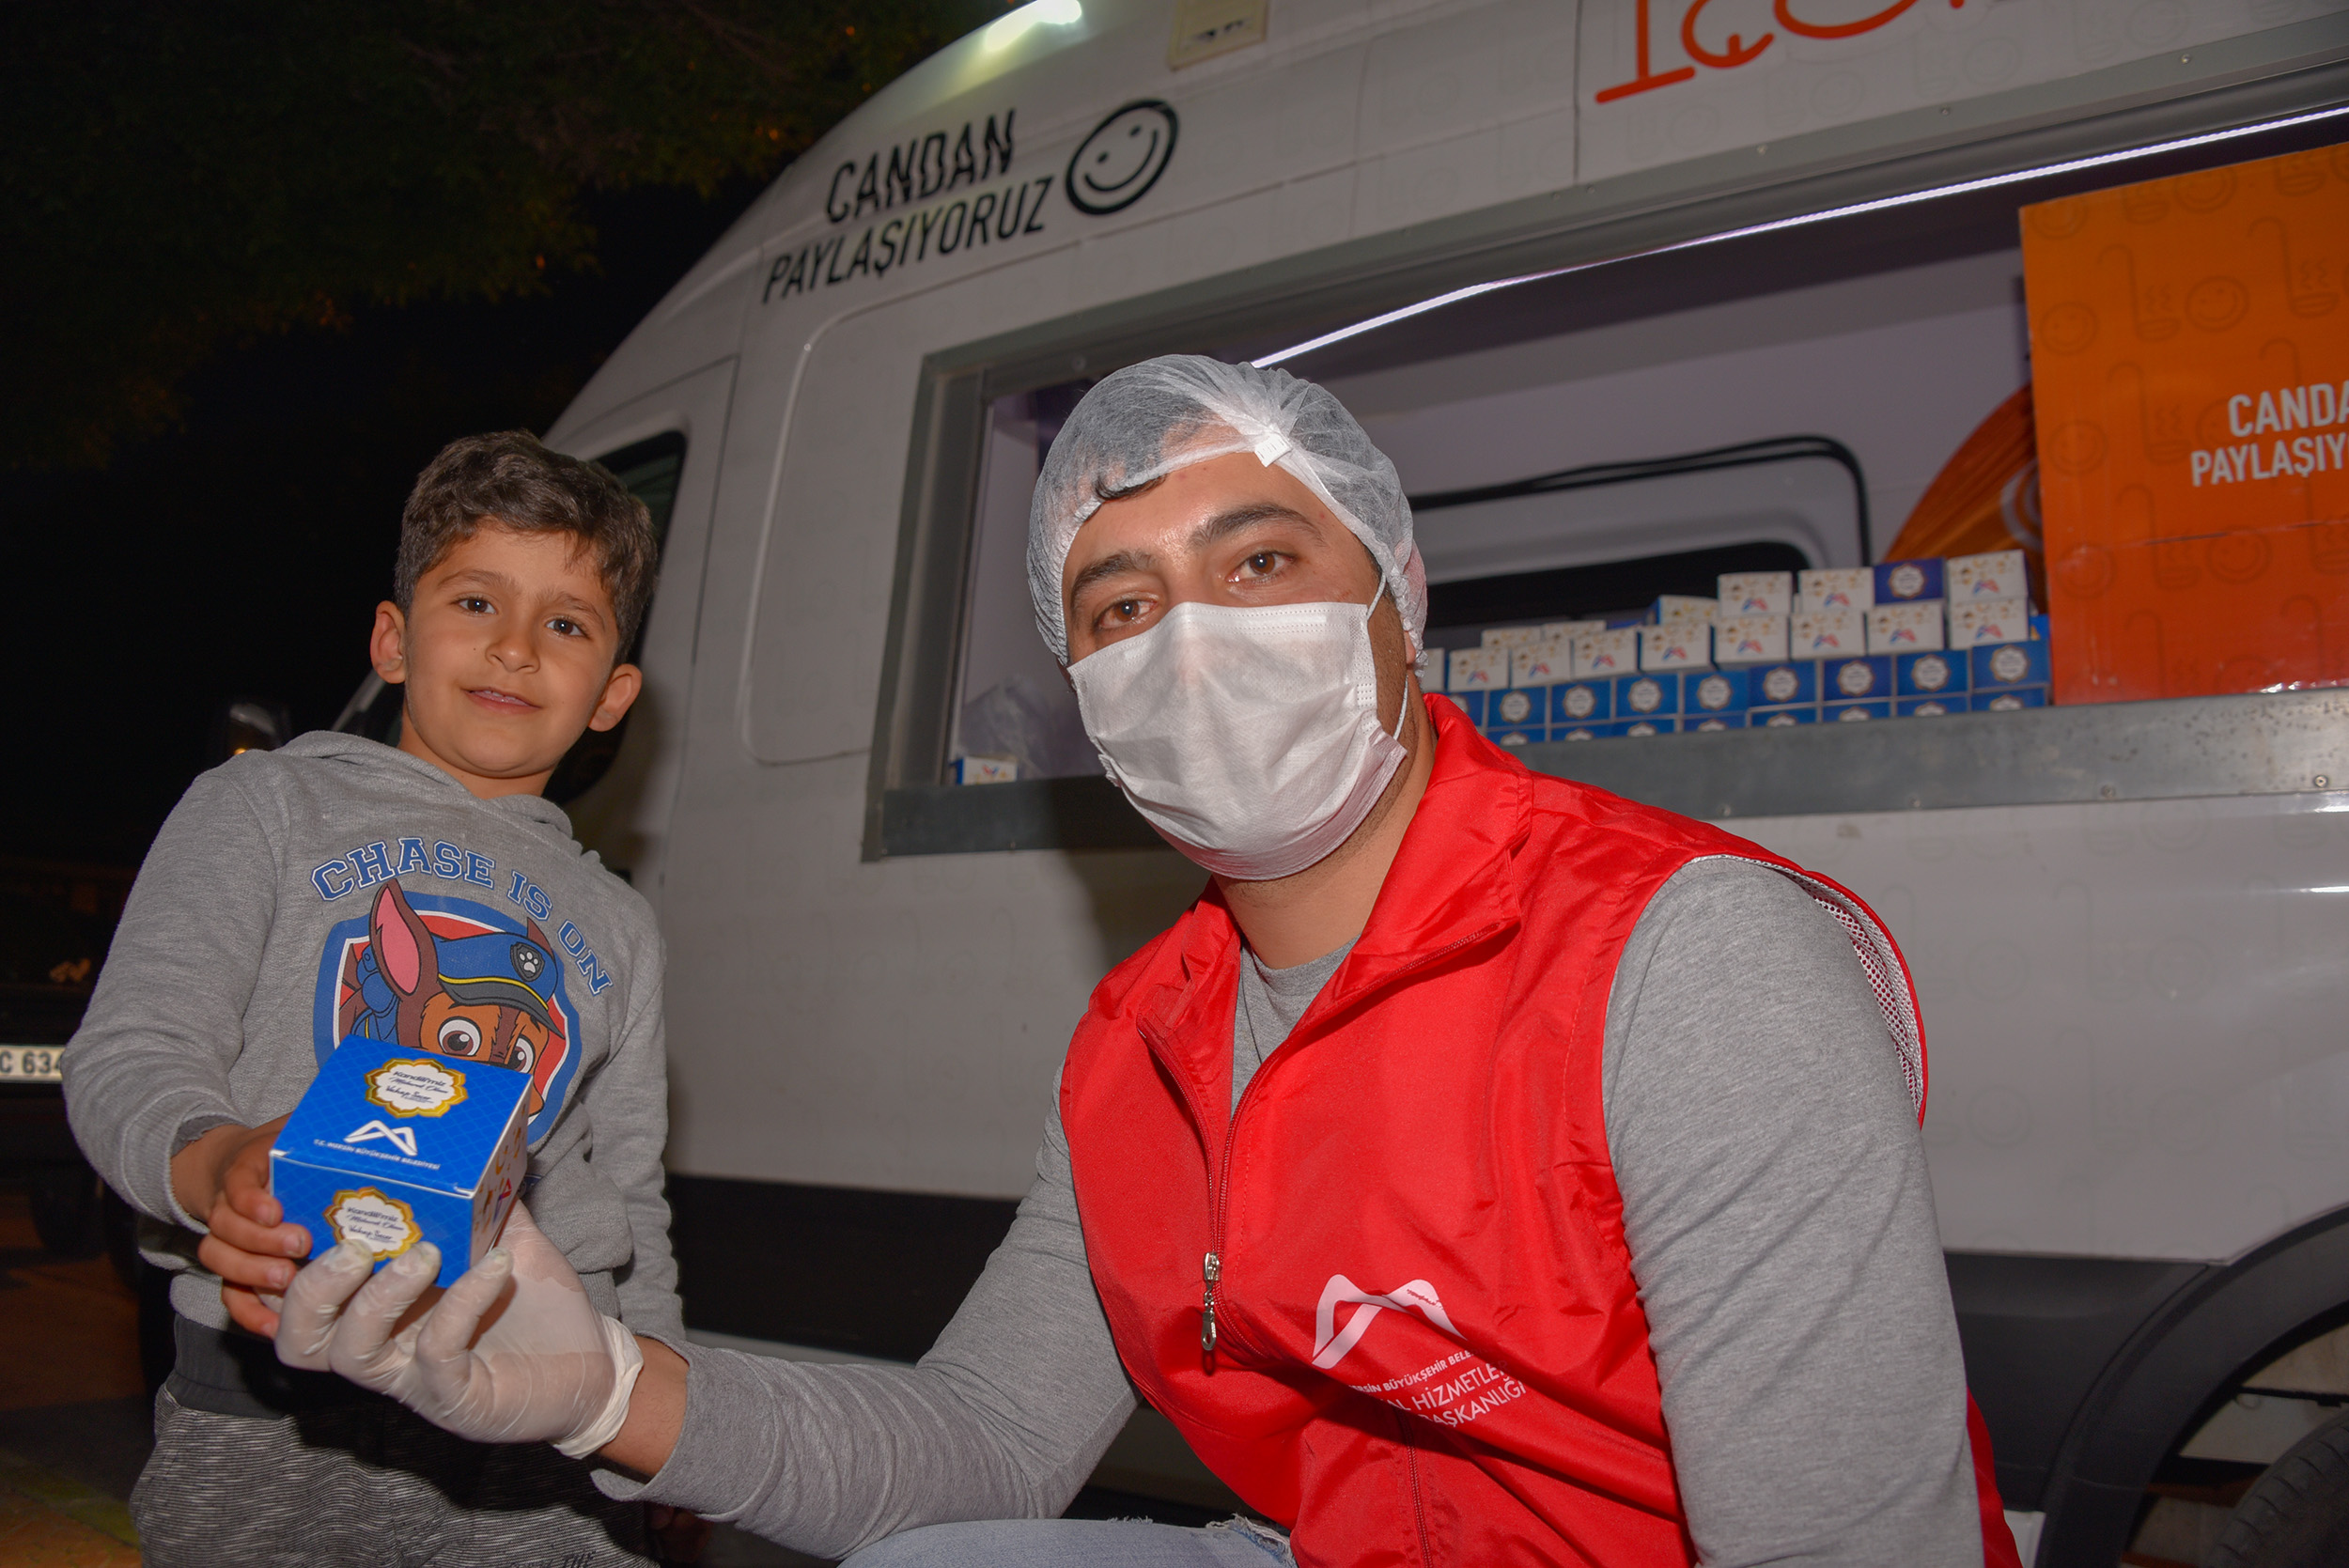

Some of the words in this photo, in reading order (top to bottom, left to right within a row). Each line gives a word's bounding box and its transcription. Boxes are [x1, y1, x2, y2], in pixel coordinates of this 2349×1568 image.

[826, 108, 1017, 224] CANDAN
[762, 176, 1054, 305] PAYLAŞIYORUZ
[2190, 431, 2349, 488] PAYLAŞIY
[311, 837, 495, 901] CHASE
[507, 870, 553, 921] IS
[557, 919, 614, 996] ON
[1382, 1358, 1448, 1392] BÜYÜKŞEHİR
[1447, 1349, 1474, 1366] BELE
